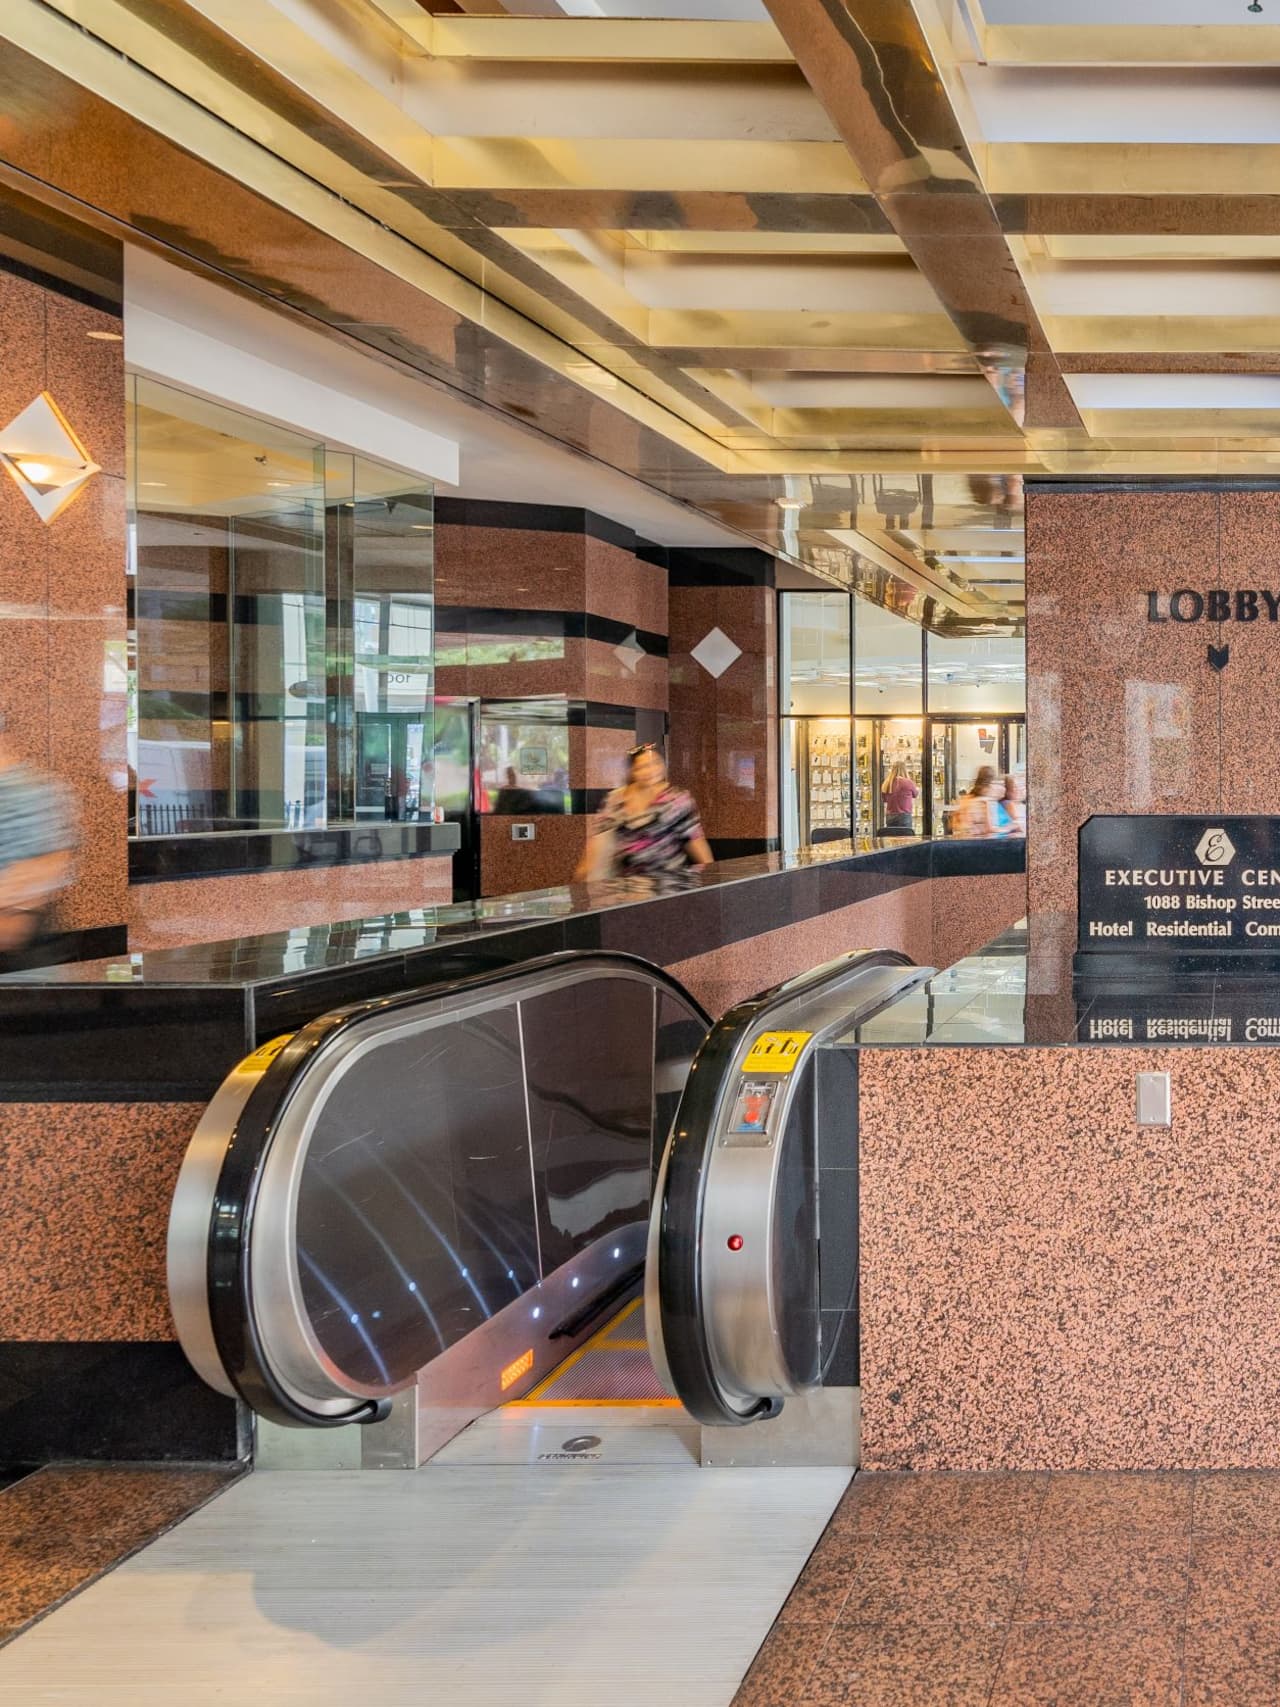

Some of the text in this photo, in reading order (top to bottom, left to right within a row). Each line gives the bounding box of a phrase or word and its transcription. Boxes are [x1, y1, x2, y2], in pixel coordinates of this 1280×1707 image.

[1105, 869, 1224, 886] EXECUTIVE
[1144, 896, 1180, 910] 1088
[1186, 895, 1237, 913] Bishop
[1089, 921, 1133, 937] Hotel
[1147, 921, 1232, 937] Residential
